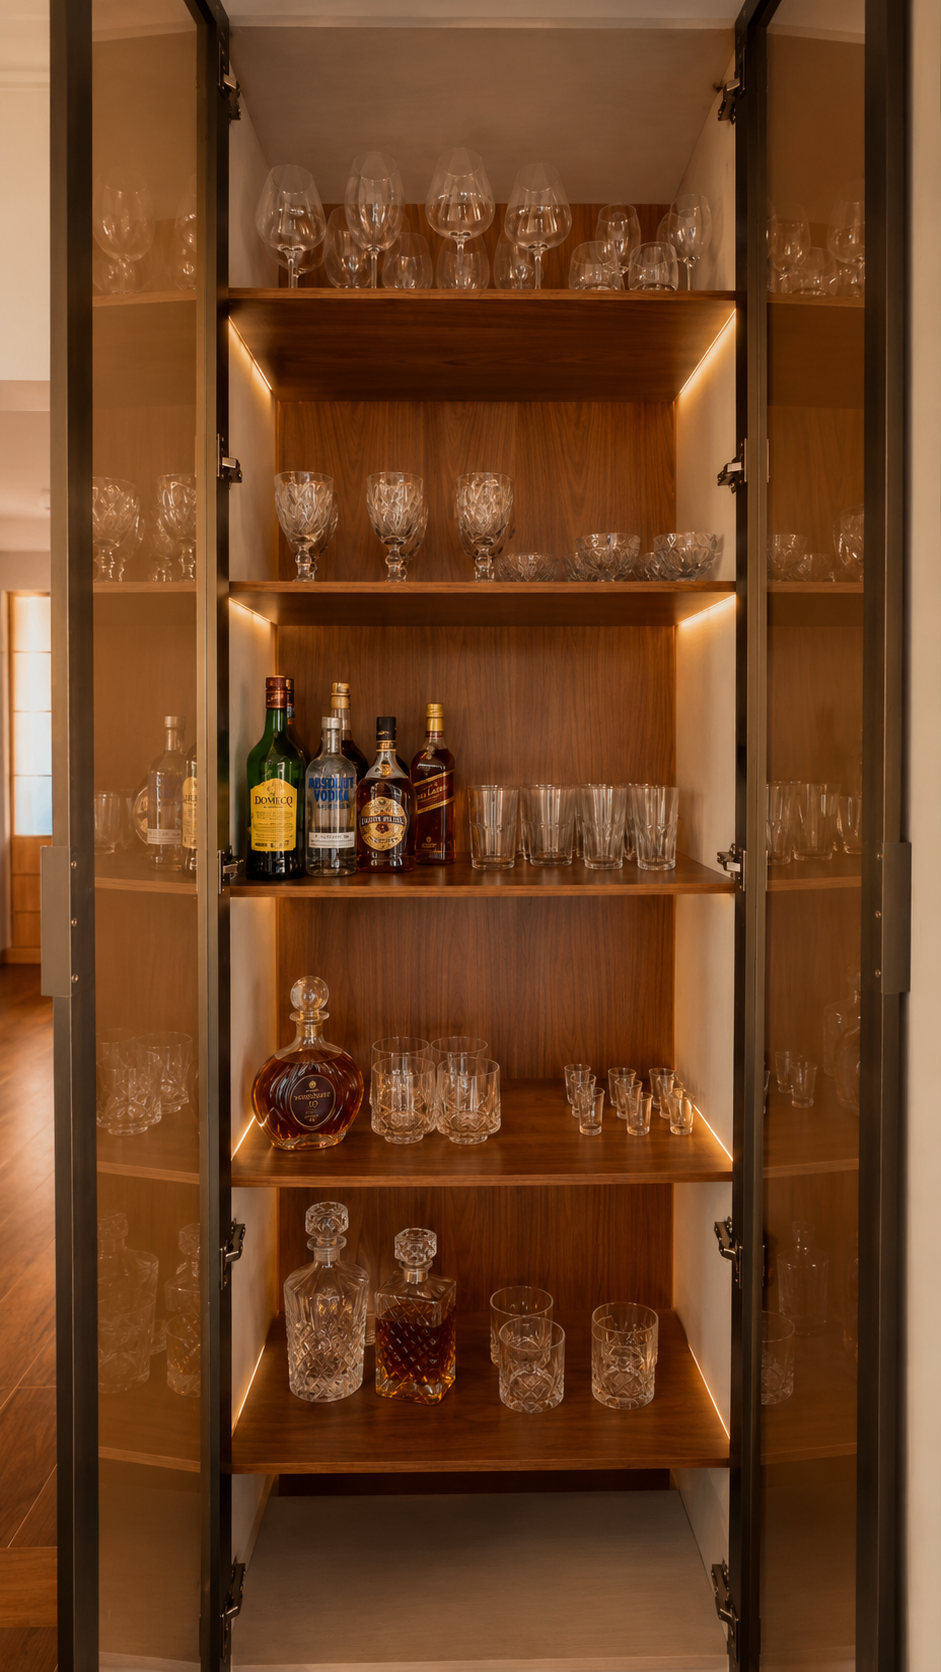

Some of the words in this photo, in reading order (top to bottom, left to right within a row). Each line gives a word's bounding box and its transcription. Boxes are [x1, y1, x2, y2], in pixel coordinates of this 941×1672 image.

[308, 777, 354, 789] ABSOLUT
[254, 795, 293, 808] DOMECQ
[314, 789, 349, 802] VODKA
